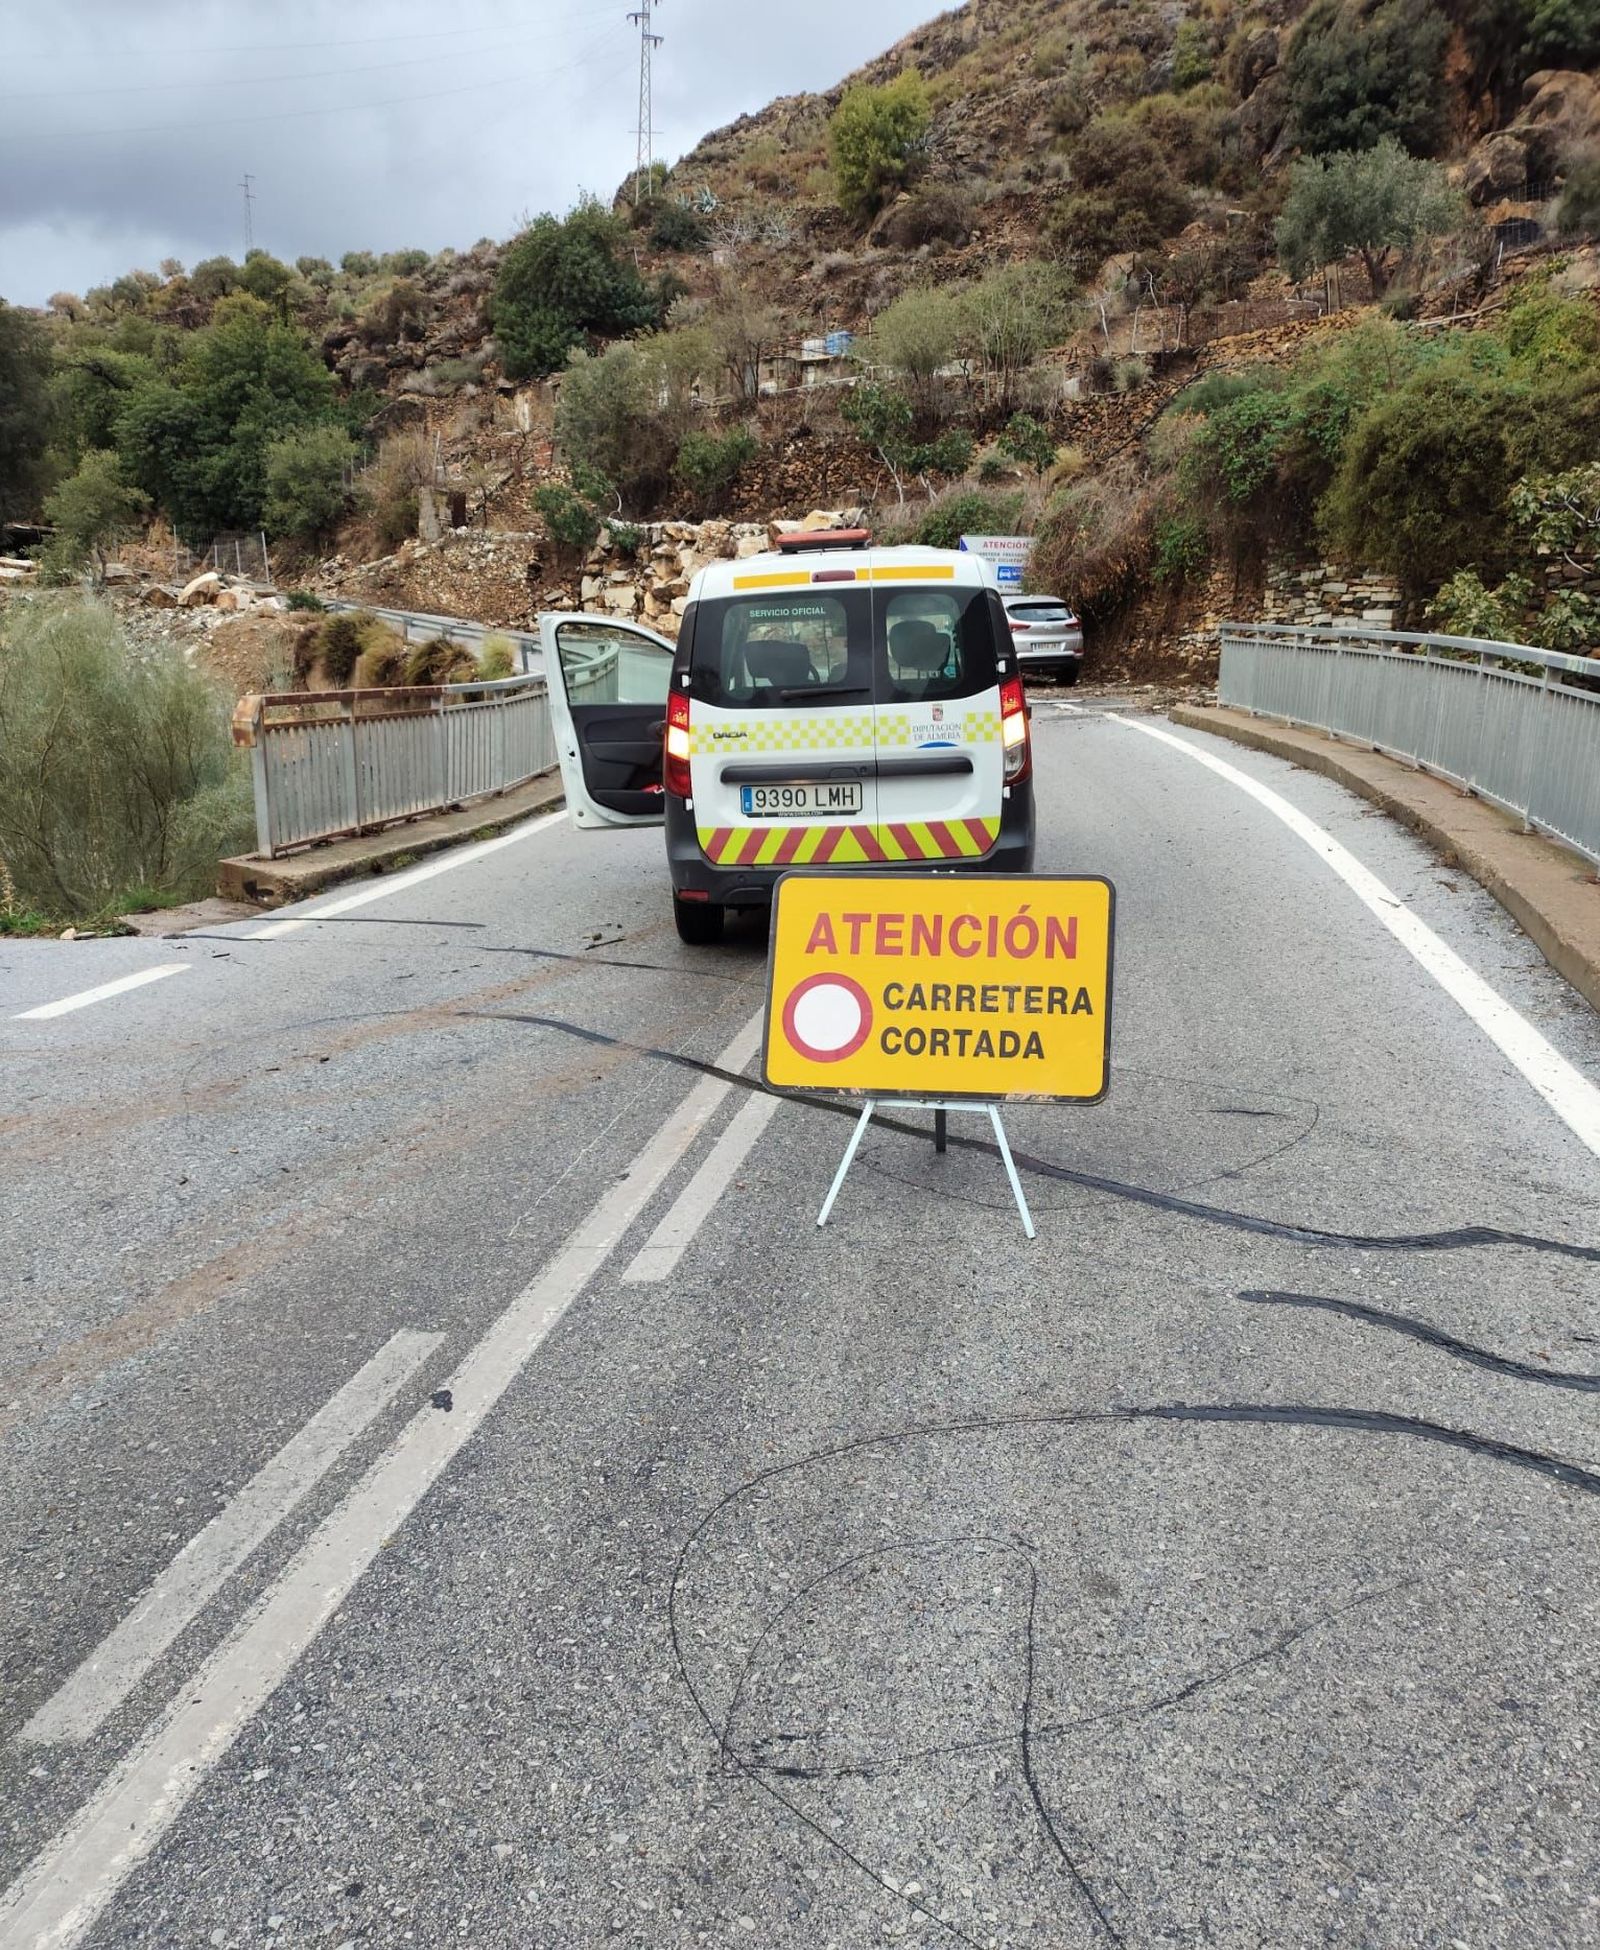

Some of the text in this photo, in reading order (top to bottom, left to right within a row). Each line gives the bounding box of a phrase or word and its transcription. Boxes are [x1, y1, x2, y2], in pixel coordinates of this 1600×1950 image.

[749, 606, 827, 617] SERVICIO OFICIAL
[713, 731, 748, 739] DACIA
[913, 733, 923, 741] DE
[755, 788, 807, 808] 9390
[815, 787, 855, 807] LMH
[804, 904, 1078, 960] ATENCIÓN
[882, 982, 1094, 1016] CARRETERA
[880, 1026, 1045, 1060] CORTADA
